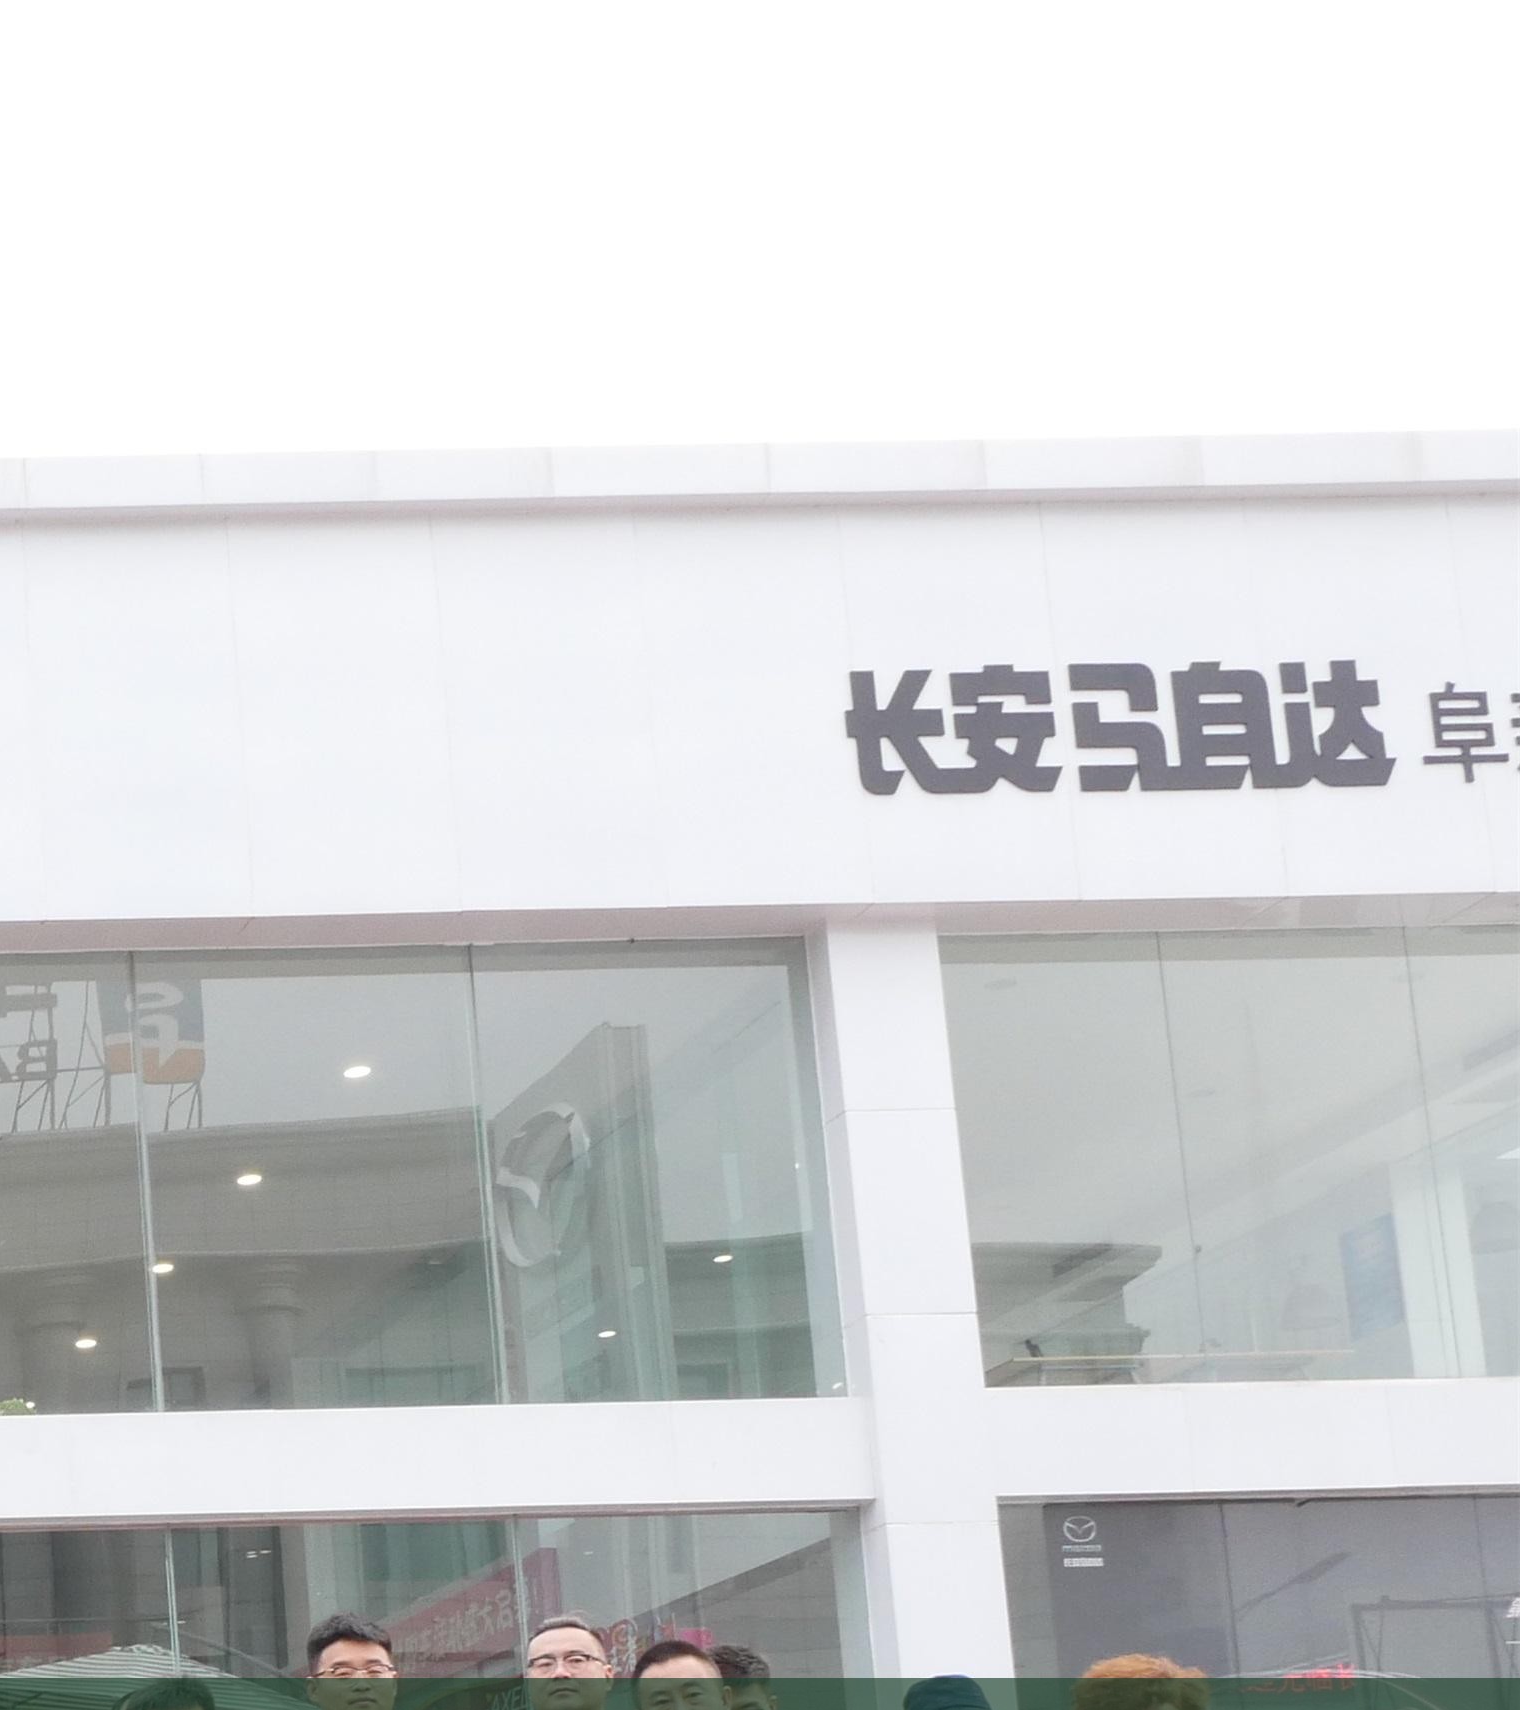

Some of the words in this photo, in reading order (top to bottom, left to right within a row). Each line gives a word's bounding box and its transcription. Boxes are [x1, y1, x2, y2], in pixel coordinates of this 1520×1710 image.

[843, 657, 1399, 796] 长安马自达
[1423, 681, 1520, 783] 阜
